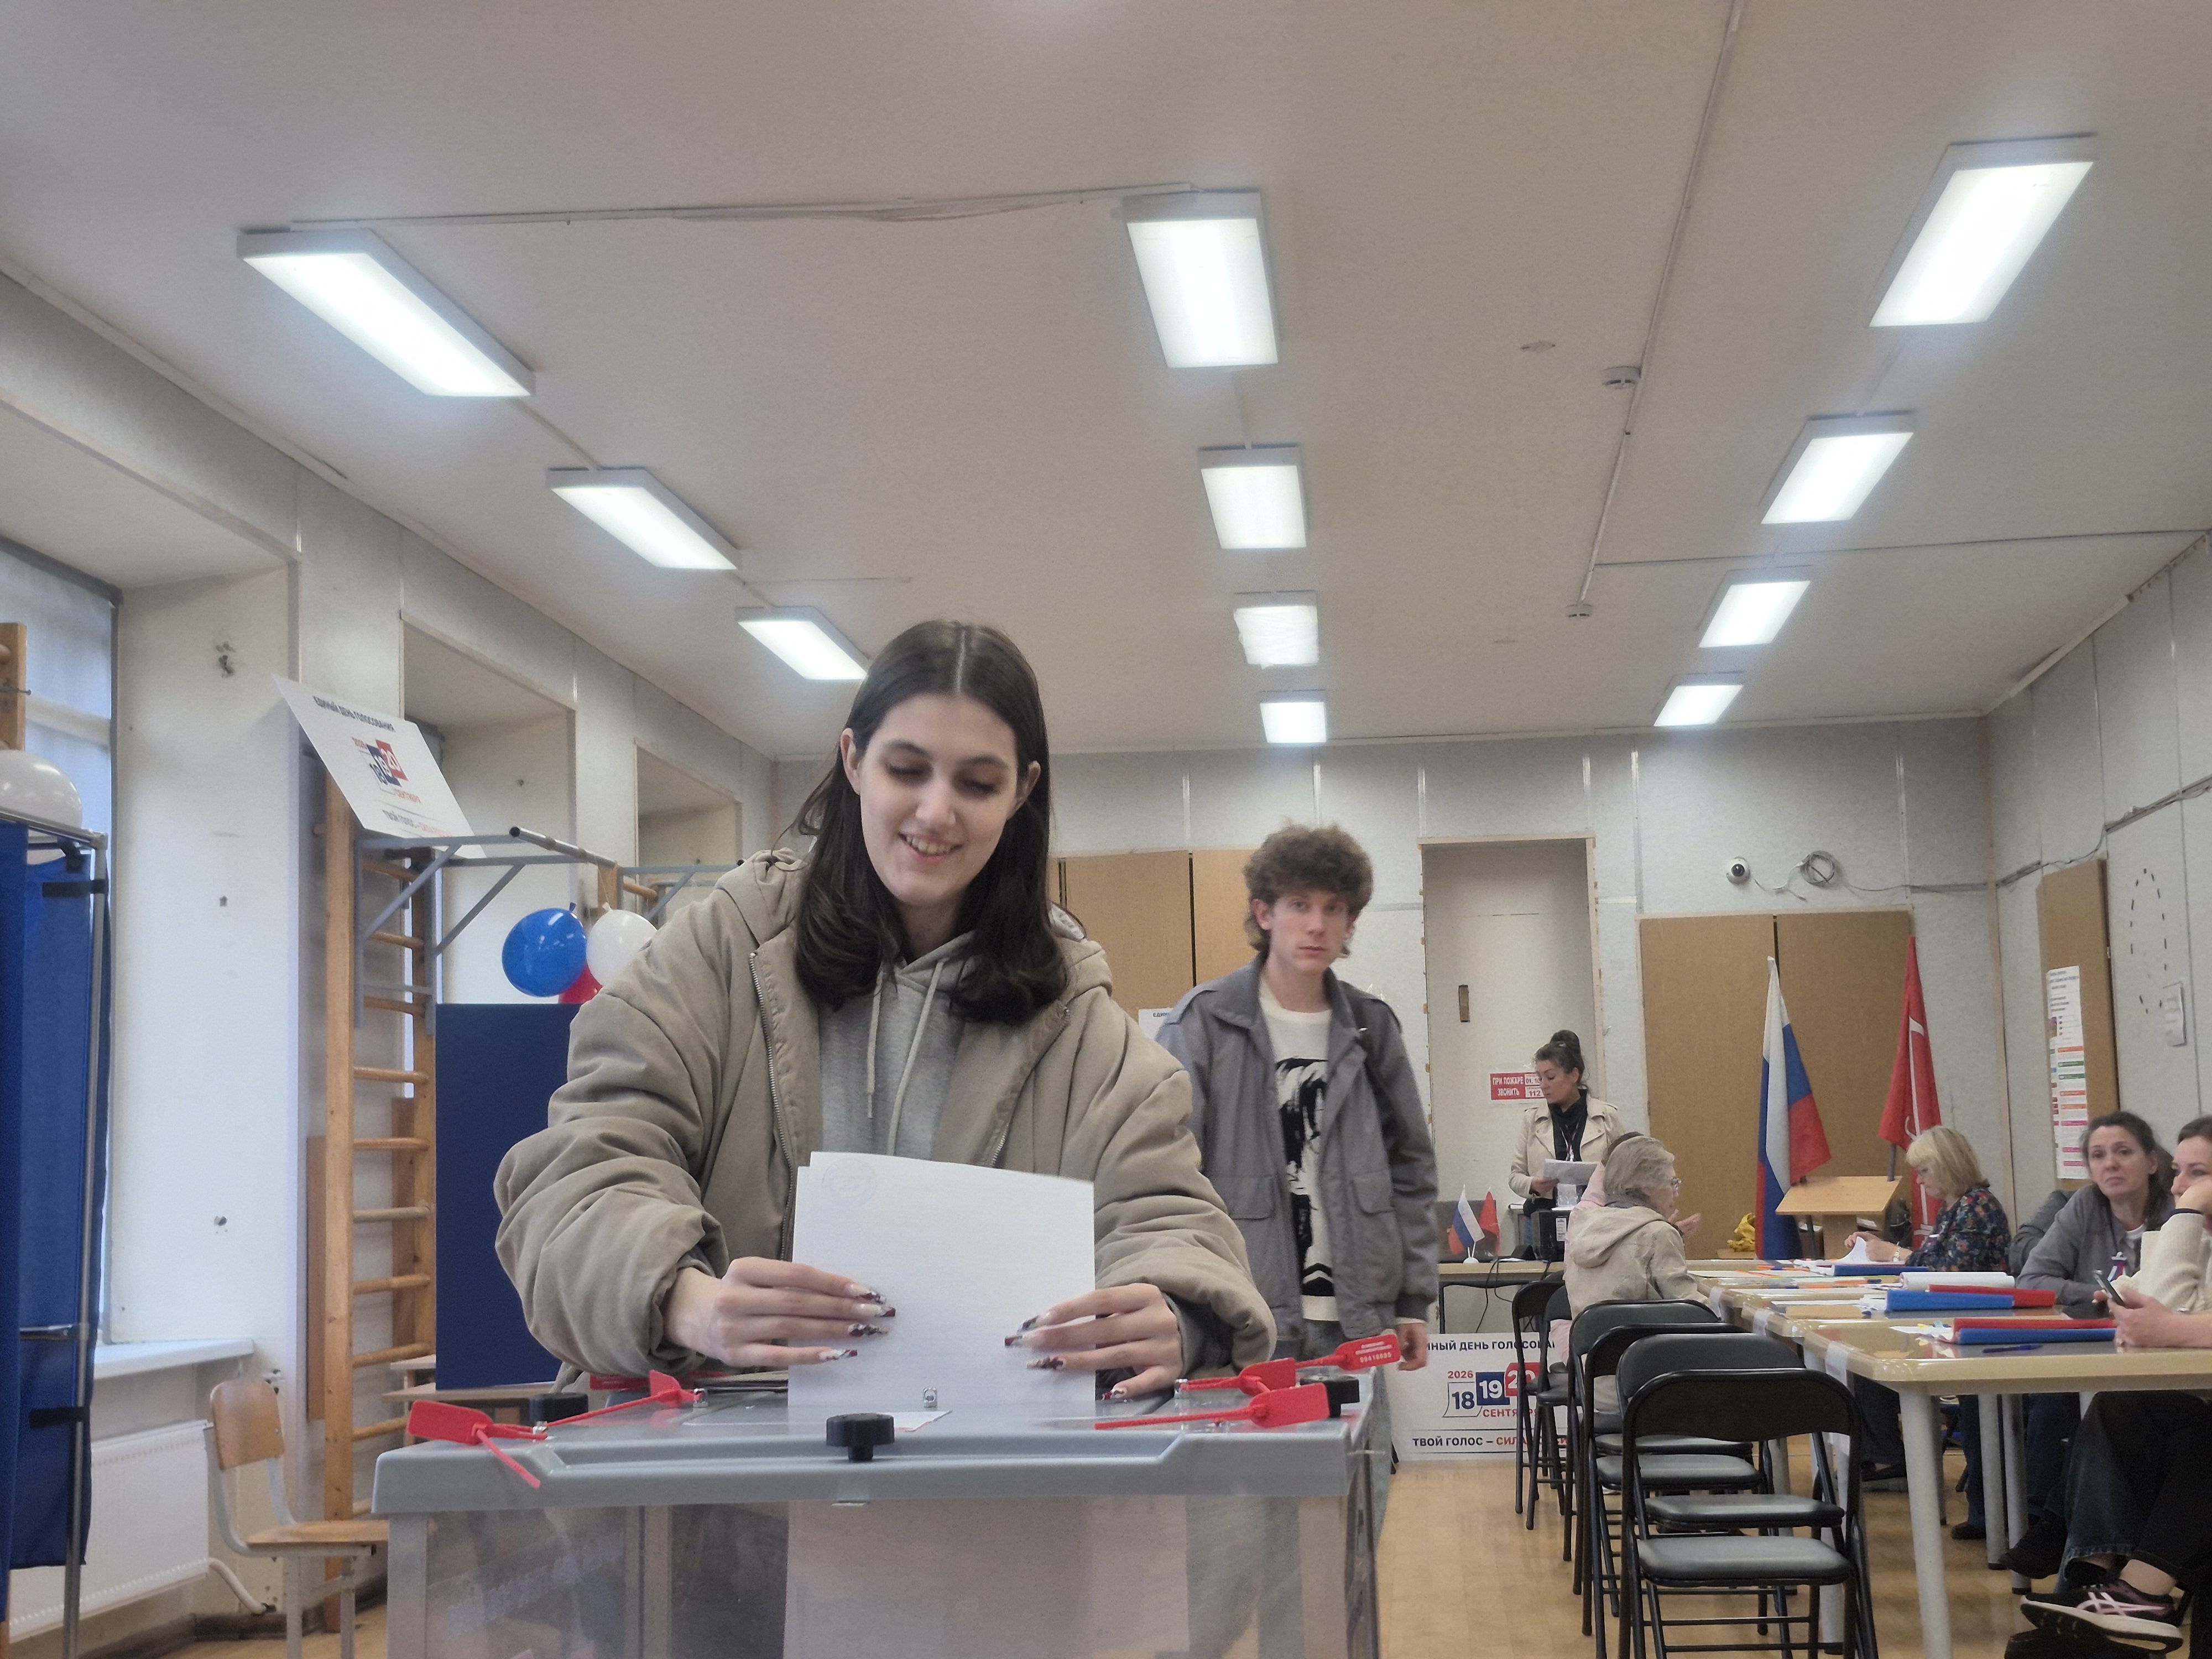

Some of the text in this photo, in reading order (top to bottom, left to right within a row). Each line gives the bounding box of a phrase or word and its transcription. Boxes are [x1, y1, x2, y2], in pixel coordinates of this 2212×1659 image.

[374, 755, 393, 777] 19
[380, 748, 401, 772] 20
[369, 763, 388, 785] 18
[1493, 1076, 1524, 1086] ПРИ ПОЖАРЕ
[1498, 1088, 1520, 1096] ЗВОНИТЬ
[1459, 1342, 1489, 1352] ДЕНЬ
[1448, 1370, 1473, 1379] 2026
[1479, 1380, 1503, 1399] 19
[1452, 1391, 1475, 1410] 18
[1412, 1436, 1443, 1446] ТВОЙ
[1446, 1437, 1483, 1446] ГОЛОС
